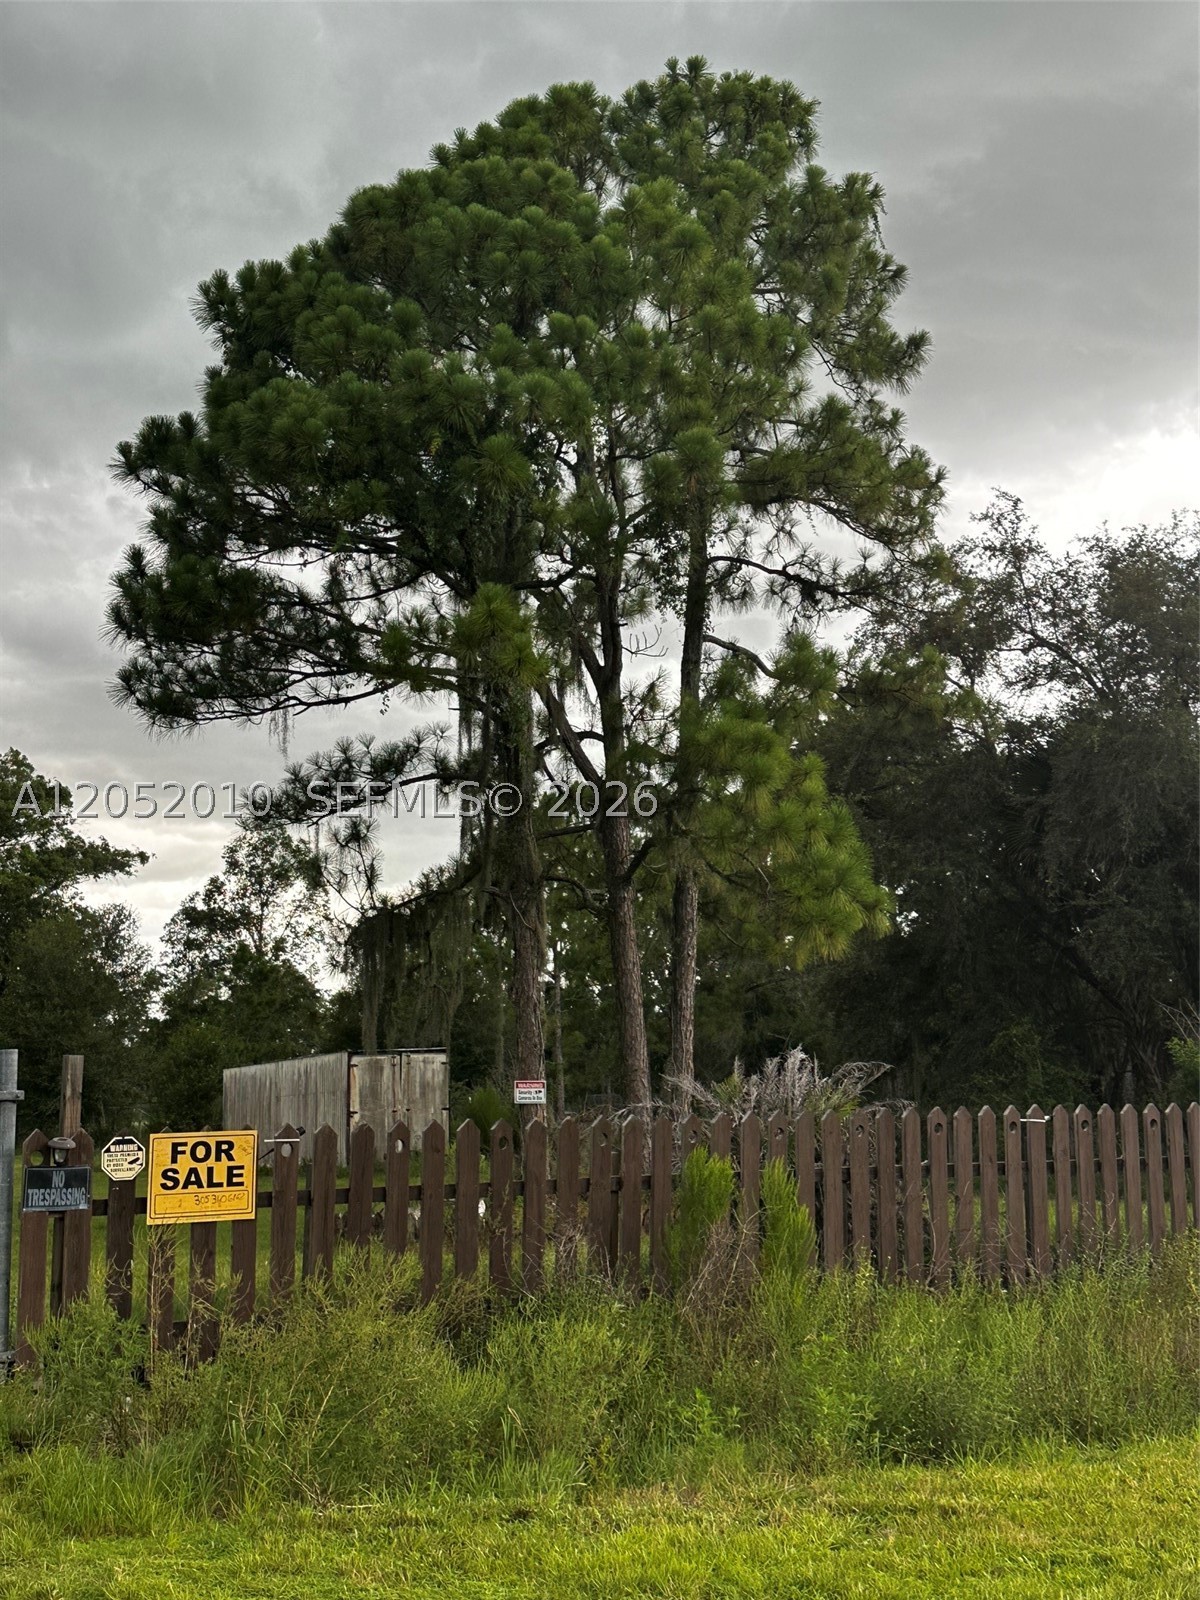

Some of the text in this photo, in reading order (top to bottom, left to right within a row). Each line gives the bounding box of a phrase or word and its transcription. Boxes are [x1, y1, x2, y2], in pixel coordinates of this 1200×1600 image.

[110, 1144, 138, 1152] WARNING
[170, 1140, 236, 1164] FOR
[51, 1170, 66, 1188] NO
[159, 1165, 245, 1191] SALE
[27, 1187, 86, 1206] TRESPASSING
